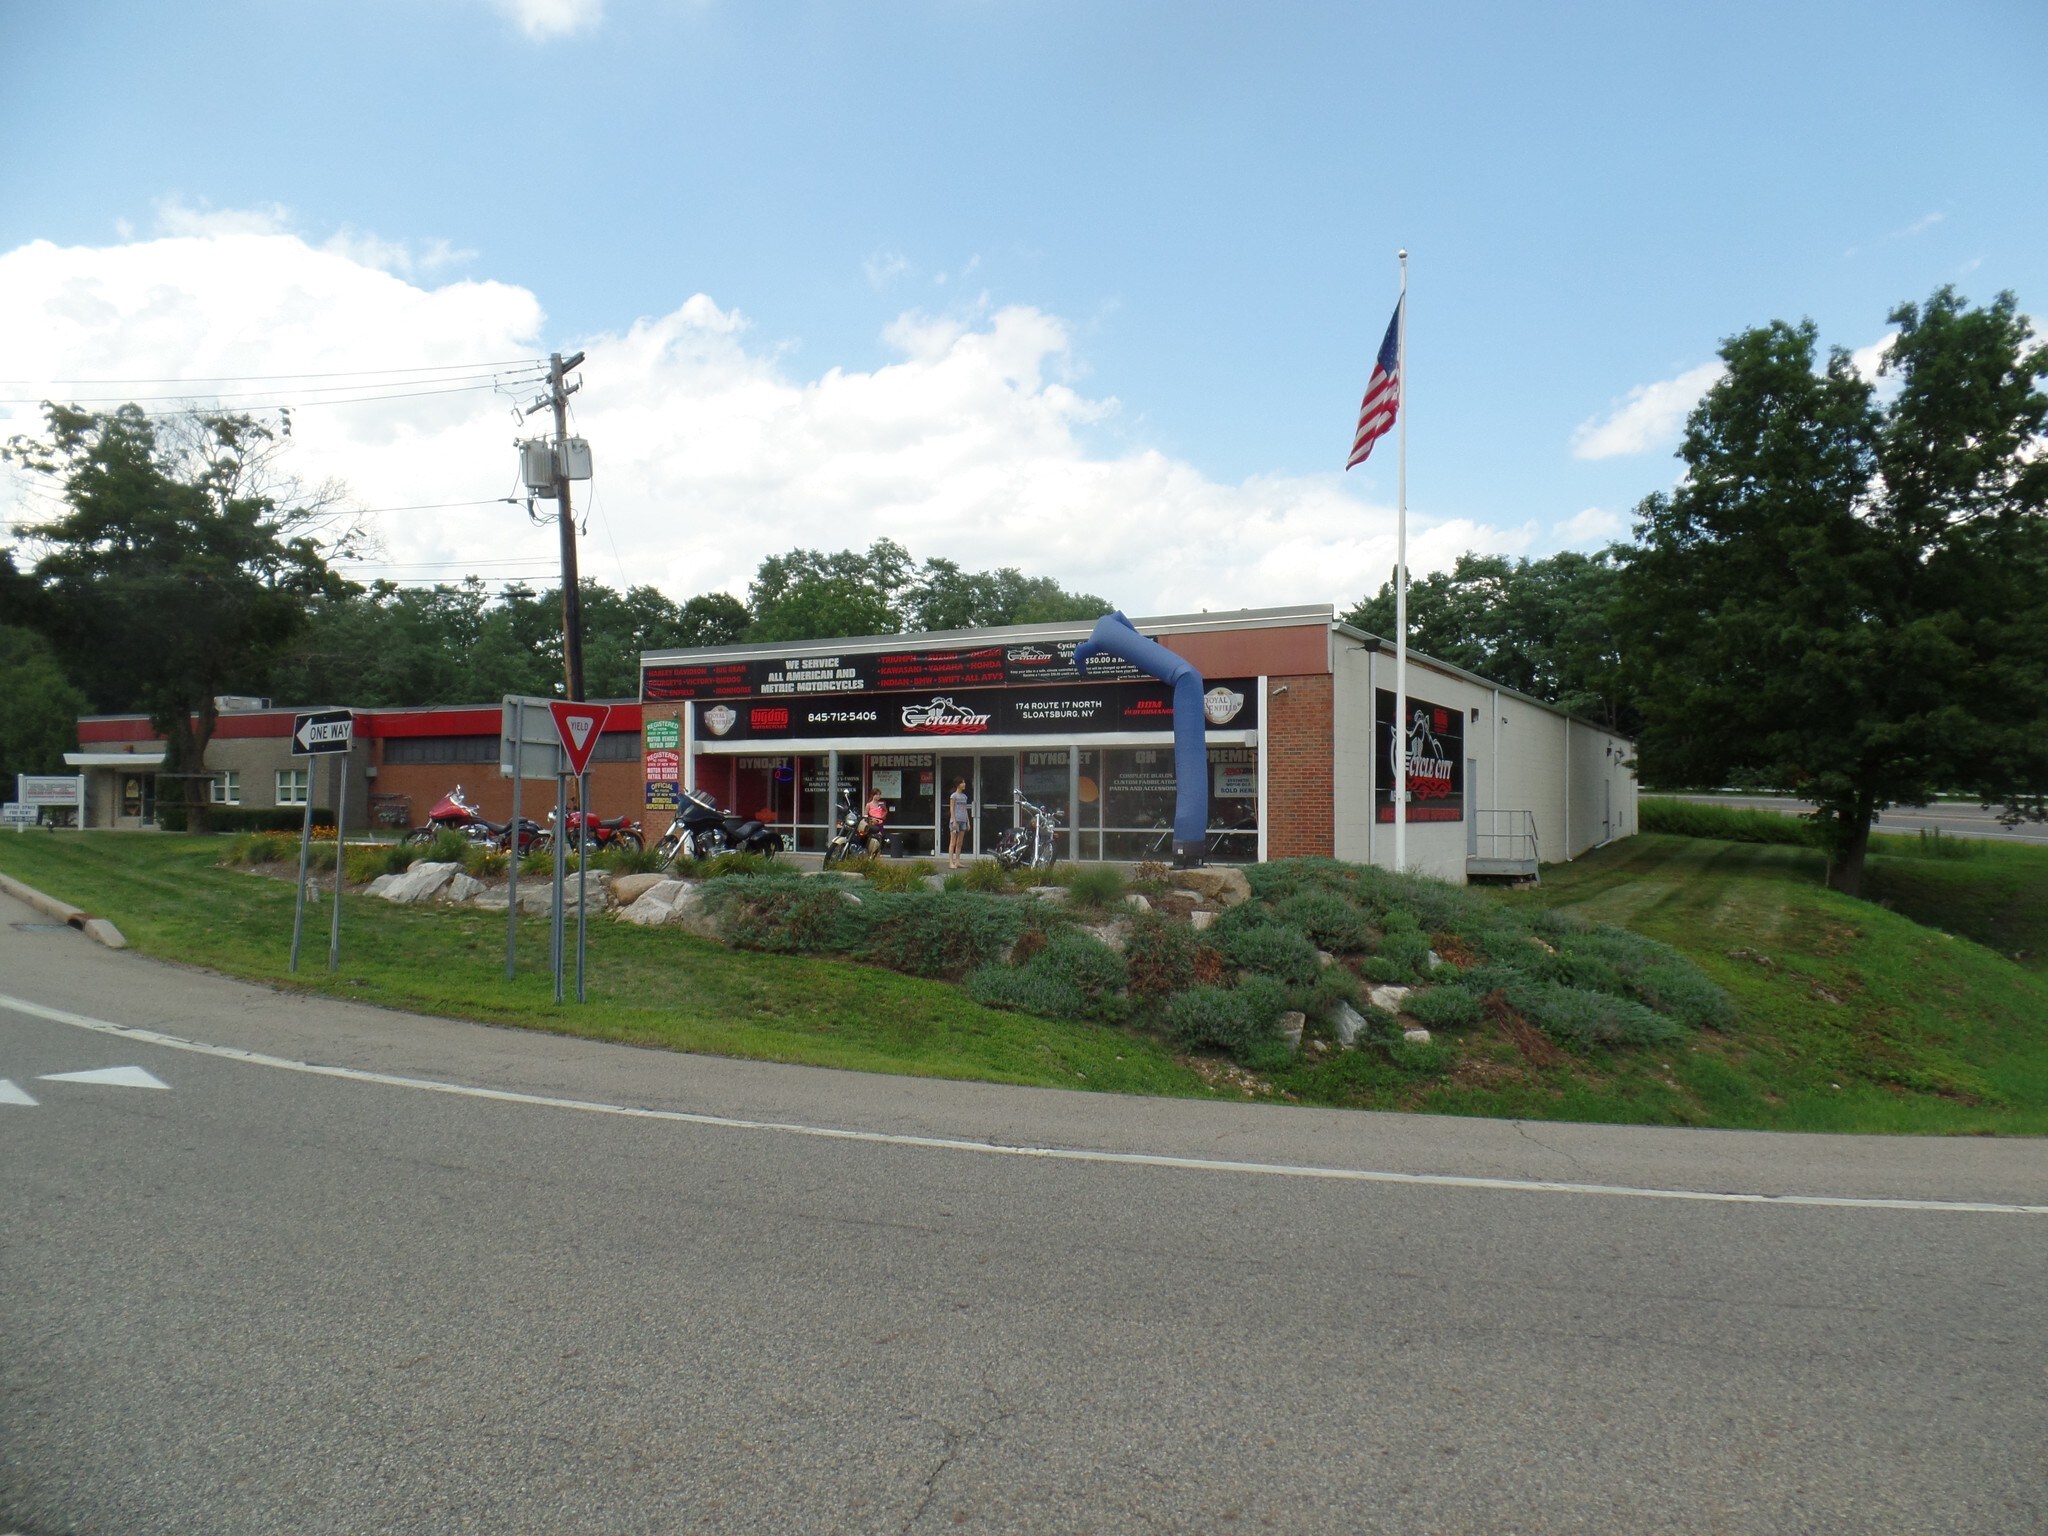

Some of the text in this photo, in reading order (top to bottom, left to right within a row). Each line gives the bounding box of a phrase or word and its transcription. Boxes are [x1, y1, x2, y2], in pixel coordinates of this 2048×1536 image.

[785, 657, 840, 670] WE SERVICE
[880, 654, 917, 663] TRIUMPH
[1085, 656, 1111, 665] $50.00
[648, 667, 707, 677] HARLEY DAVIDSON
[880, 660, 1002, 675] KAWASAKI YAMAHA HONDA
[768, 668, 856, 682] ALL AMERICAN AND
[880, 678, 910, 687] INDIAN
[913, 676, 933, 685] BMW
[937, 675, 960, 683] SWIFT
[964, 674, 979, 682] ALL
[669, 688, 695, 696] ENFIELD
[760, 680, 864, 693] METRIC MOTORCYCLES
[1015, 700, 1102, 710] 174 ROUTE 17 NORTH
[1081, 709, 1094, 718] NY
[570, 720, 589, 732] YIELD
[647, 720, 679, 730] REGISTERED
[925, 714, 991, 726] CYCLE CITY
[310, 720, 350, 741] ONE WAY
[647, 751, 679, 762] REGISTERED
[870, 754, 932, 768] PREMISES
[1135, 750, 1157, 764] ON
[738, 757, 789, 769] DYNOJET
[1409, 757, 1454, 780] CYCLE CITY
[651, 782, 673, 790] OFFICIAL
